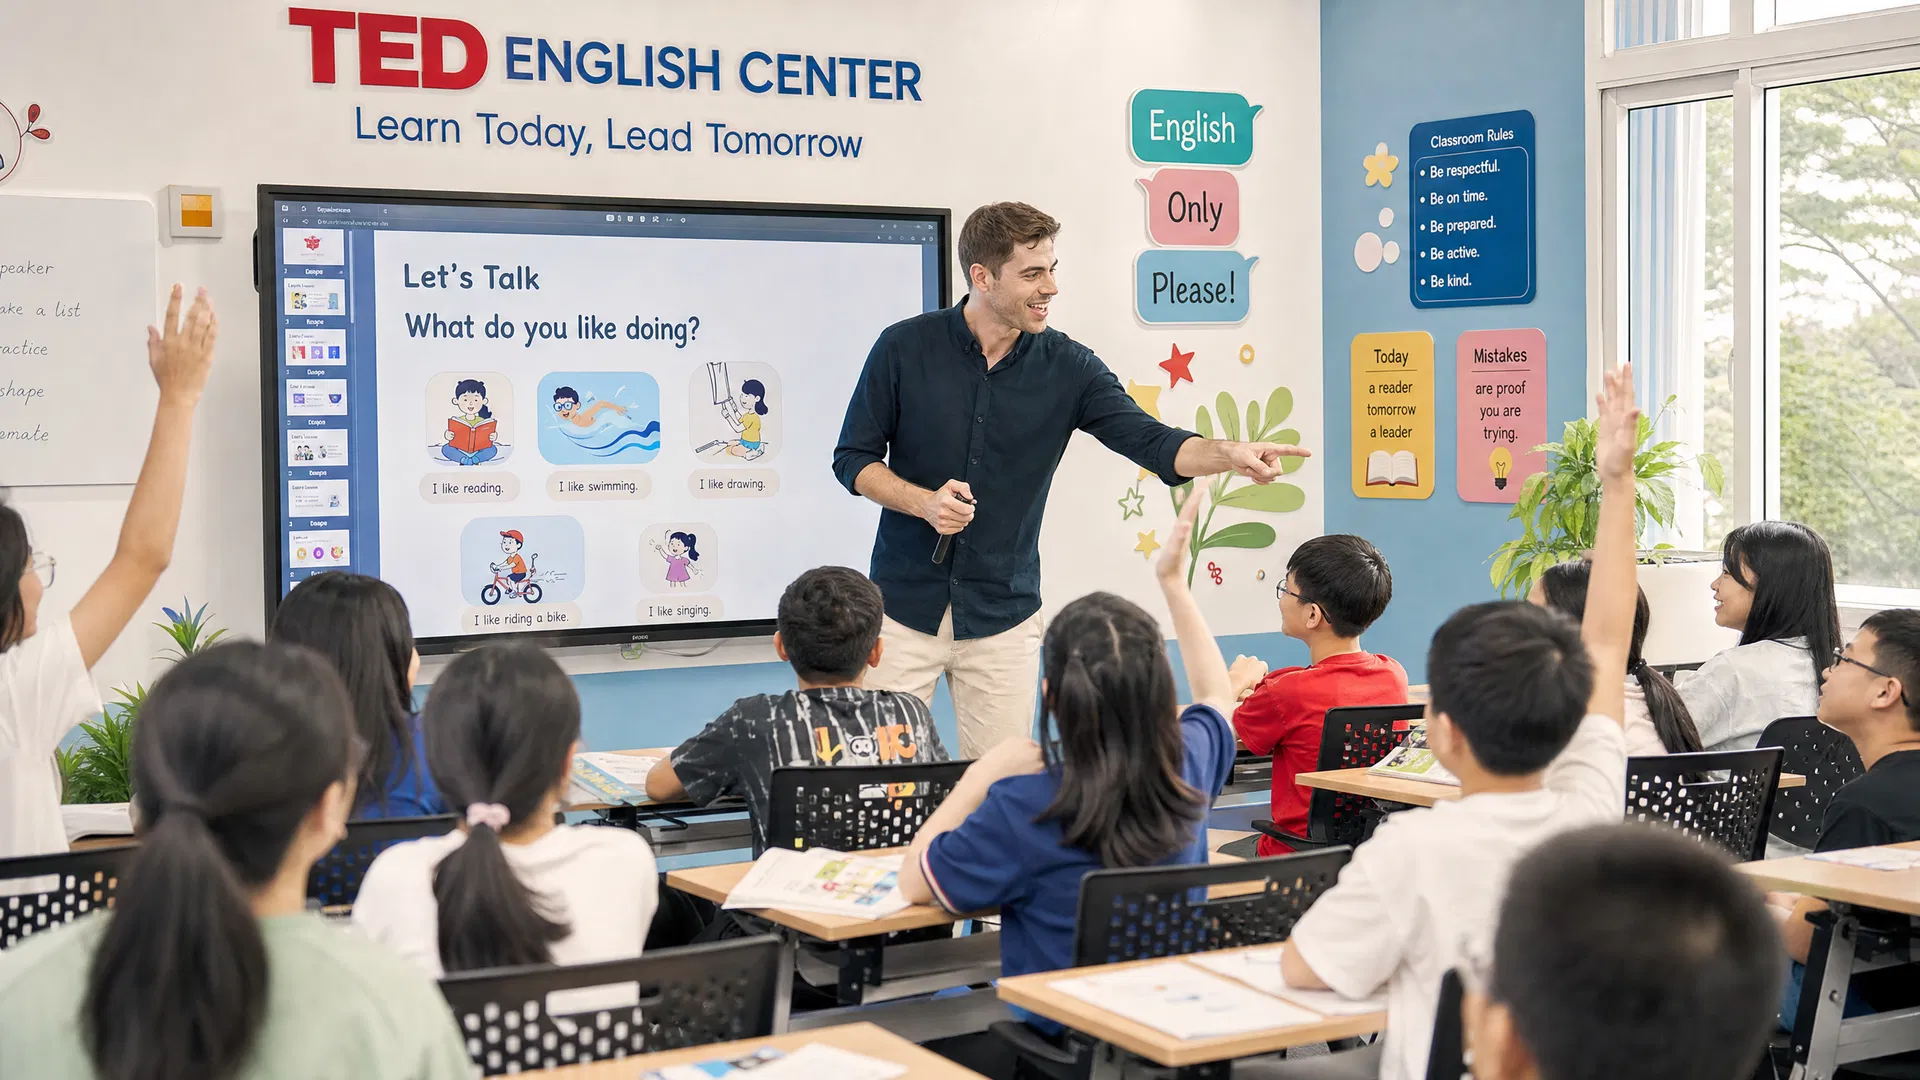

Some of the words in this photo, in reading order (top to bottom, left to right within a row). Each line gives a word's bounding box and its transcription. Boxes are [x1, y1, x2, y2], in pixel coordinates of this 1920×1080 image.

[289, 7, 488, 90] TED
[506, 36, 720, 91] ENGLISH
[739, 51, 922, 101] CENTER
[356, 107, 460, 143] Learn
[477, 113, 592, 156] Today,
[608, 118, 691, 151] Lead
[706, 123, 862, 158] Tomorrow
[1151, 110, 1235, 151] English
[1430, 133, 1484, 149] Classroom
[1487, 127, 1514, 142] Rules
[1430, 165, 1444, 179] Be
[1446, 158, 1501, 179] respectful.
[1430, 192, 1444, 206] Be
[1446, 193, 1460, 204] on
[1462, 189, 1488, 203] time.
[1169, 191, 1222, 231] Only
[1430, 219, 1444, 233] Be
[1446, 215, 1497, 236] prepared.
[1430, 247, 1445, 261] Be
[1446, 245, 1480, 260] active.
[405, 263, 472, 289] Let's
[482, 264, 540, 291] Talk
[1430, 274, 1445, 288] Be
[1447, 272, 1472, 287] kind.
[1153, 271, 1234, 304] Please!
[35, 307, 47, 317] a
[55, 300, 81, 318] list
[404, 312, 475, 339] What
[484, 313, 515, 339] do
[523, 321, 568, 348] you
[578, 314, 617, 340] like
[627, 315, 699, 348] doing?
[1373, 348, 1409, 368] Today
[1474, 346, 1528, 364] Mistakes
[1368, 384, 1376, 395] a
[1378, 379, 1414, 394] reader
[1475, 384, 1493, 395] are
[1496, 379, 1527, 399] proof
[1366, 403, 1417, 416] tomorrow
[1479, 406, 1500, 421] you
[1502, 406, 1521, 417] are
[1370, 428, 1377, 439] a
[1379, 424, 1413, 439] leader
[1483, 426, 1518, 444] trying.
[432, 482, 438, 495] I
[442, 482, 459, 494] like
[463, 482, 504, 497] reading.
[559, 481, 564, 493] I
[568, 480, 585, 492] like
[588, 480, 638, 494] swimming.
[699, 478, 705, 490] I
[708, 478, 724, 490] like
[726, 478, 766, 492] drawing.
[474, 614, 479, 627] I
[483, 614, 500, 625] like
[504, 612, 533, 627] riding
[536, 614, 543, 623] a
[547, 611, 569, 623] bike.
[648, 605, 654, 618] I
[657, 605, 673, 617] like
[676, 604, 712, 619] singing.
